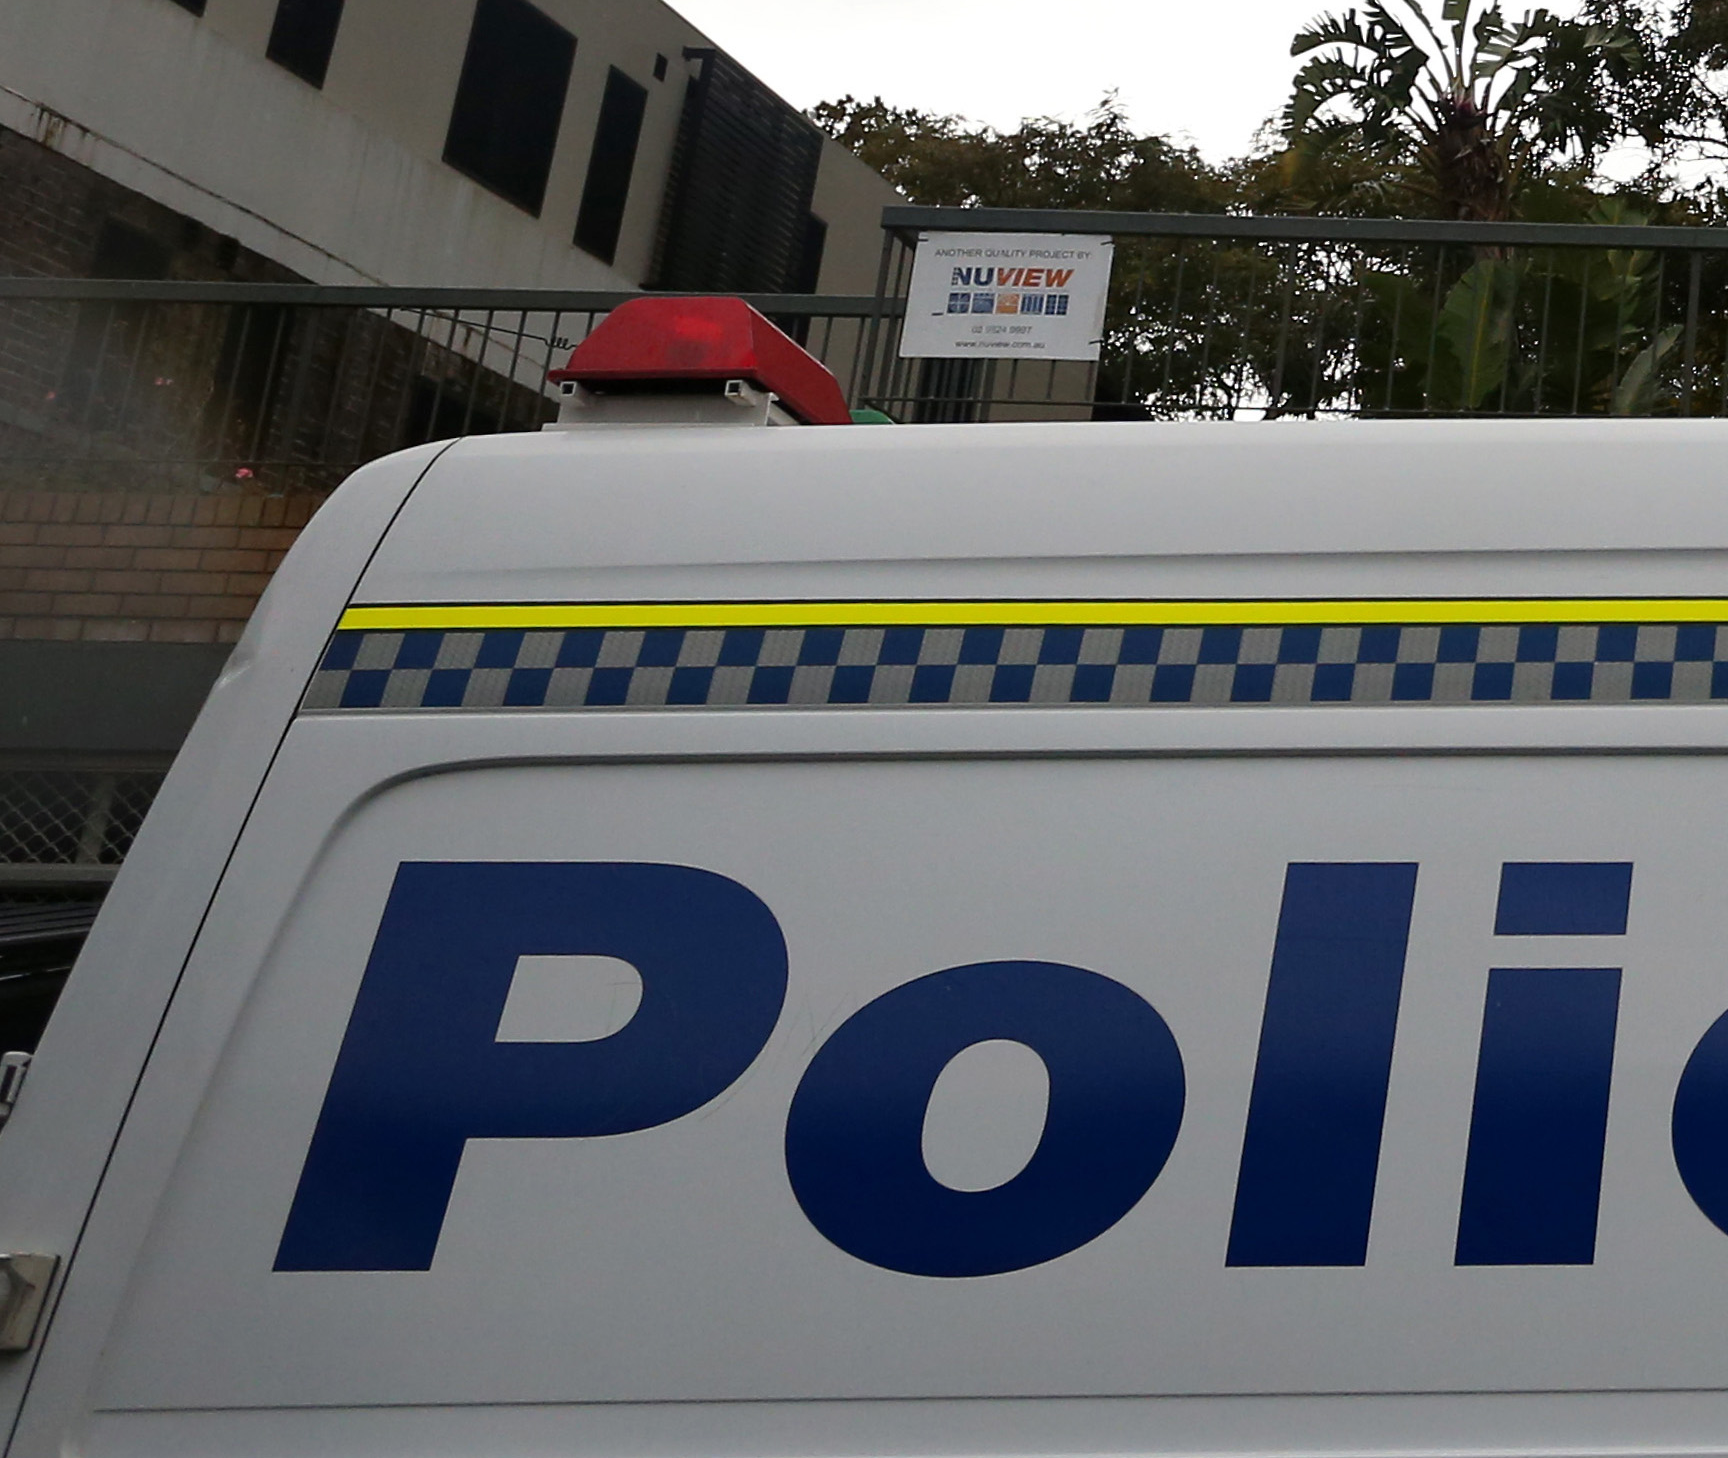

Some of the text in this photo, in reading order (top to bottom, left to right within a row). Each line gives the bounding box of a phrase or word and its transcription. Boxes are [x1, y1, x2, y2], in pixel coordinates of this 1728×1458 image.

[935, 248, 982, 258] ANOTHER
[985, 249, 1026, 258] QUALITY
[1029, 250, 1074, 259] PROJECT
[951, 266, 1075, 288] NUVIEW
